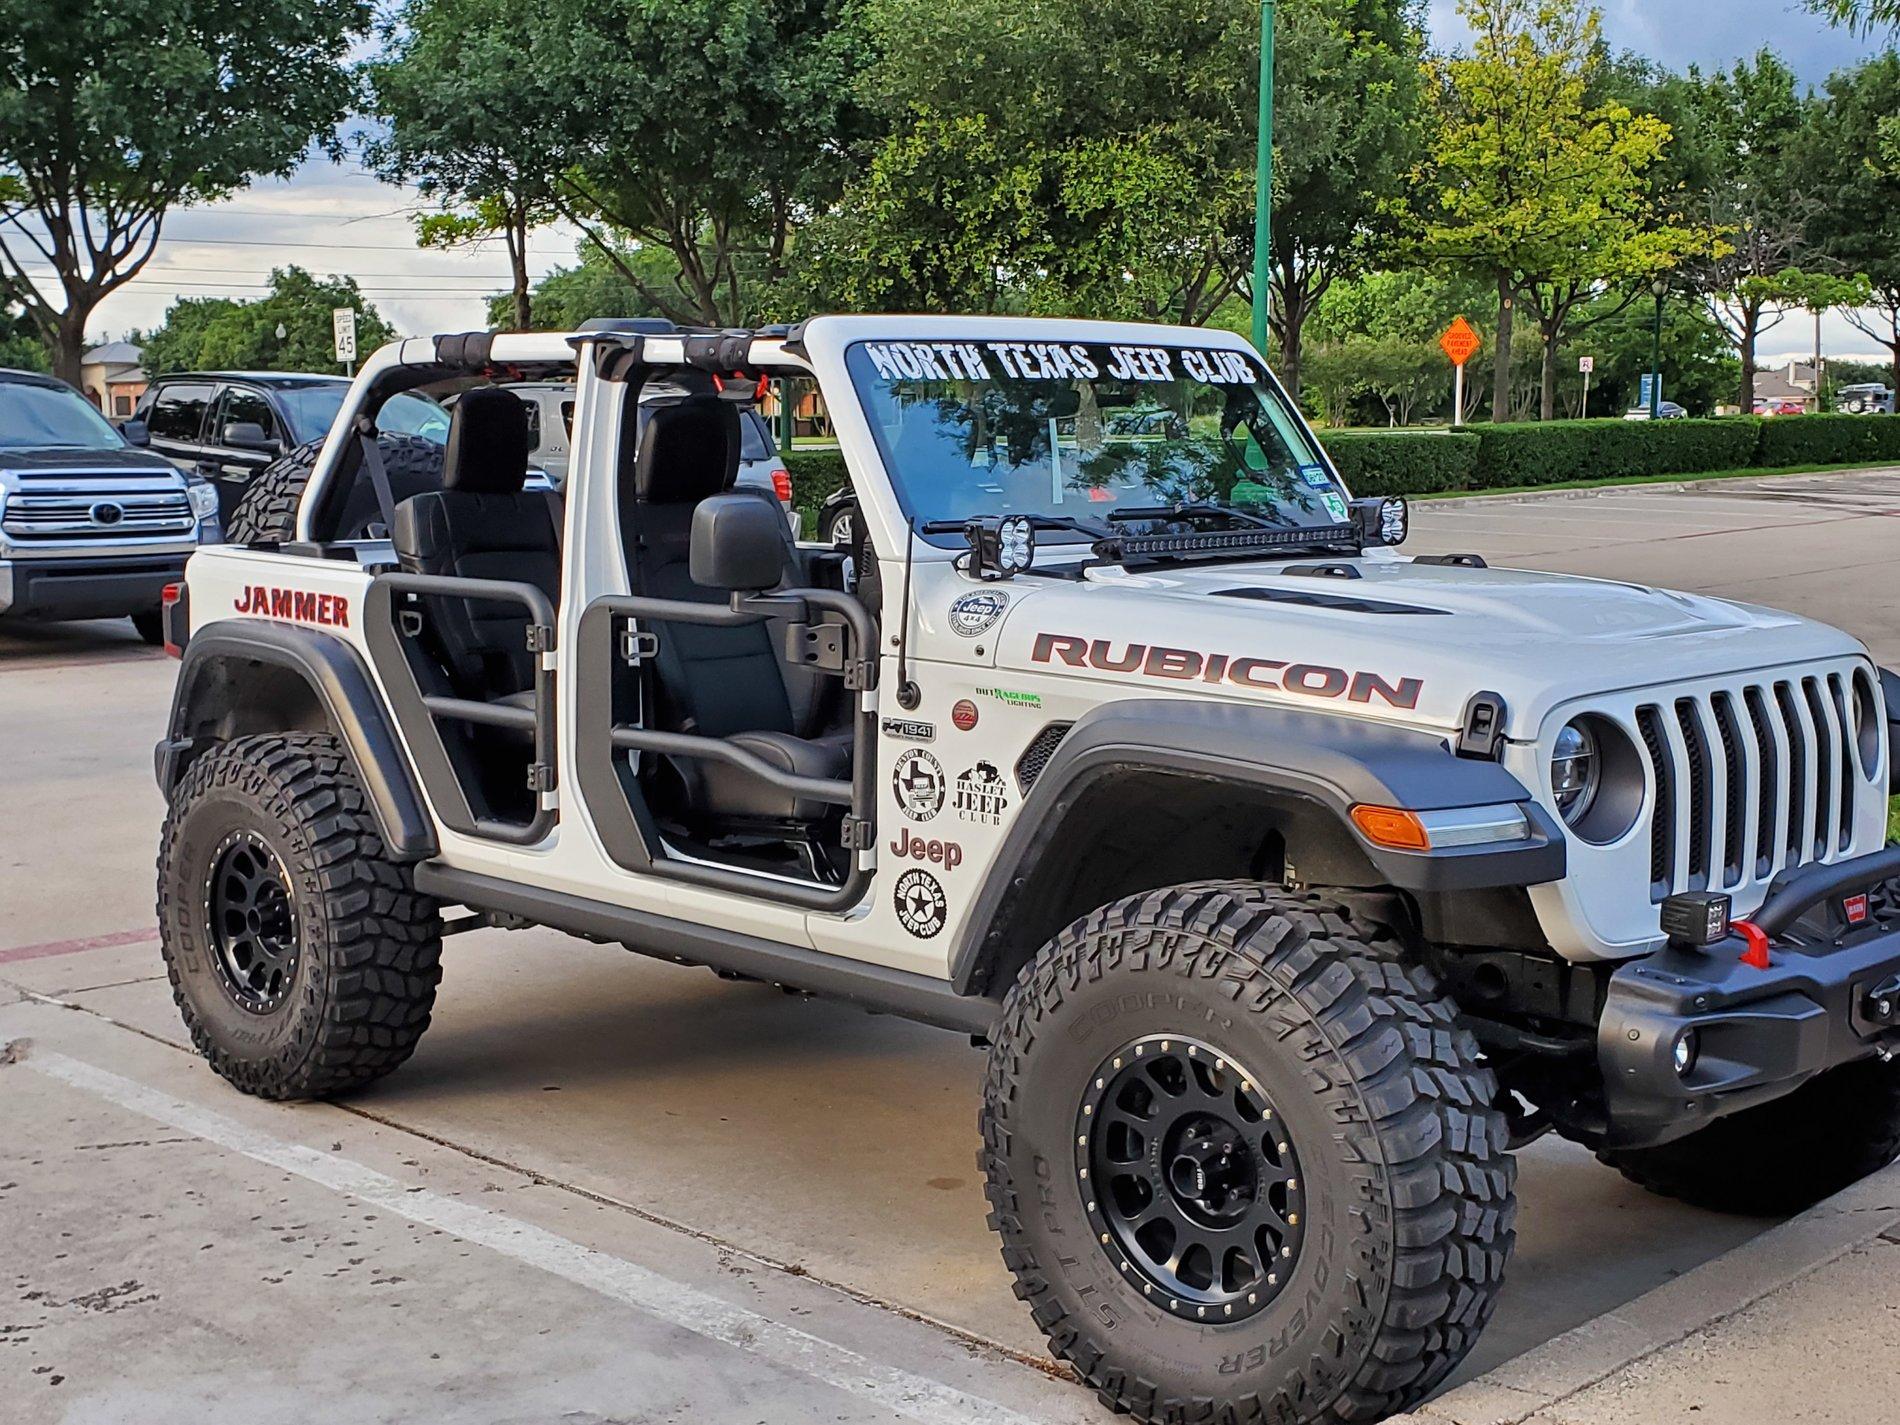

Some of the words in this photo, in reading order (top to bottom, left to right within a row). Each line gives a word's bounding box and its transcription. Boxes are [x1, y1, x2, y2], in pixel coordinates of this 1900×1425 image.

[336, 314, 352, 323] SPEED
[338, 336, 353, 354] 45
[868, 343, 991, 380] NORTH
[987, 344, 1099, 379] TEXAS
[1106, 346, 1175, 382] JEEP
[1180, 350, 1257, 384] CLUB
[234, 585, 349, 628] JAMMER
[962, 602, 993, 616] Jeep
[1031, 632, 1424, 709] RUBICON
[1006, 699, 1042, 709] LIGHTING
[904, 724, 932, 737] 1941
[896, 749, 918, 772] DENTON
[921, 750, 943, 776] COUNTY
[957, 780, 1006, 796] HASLET
[952, 791, 1008, 815] JEEP
[959, 810, 1000, 826] CLUB
[890, 827, 962, 871] Jeep
[897, 872, 920, 899] NORTH
[920, 873, 944, 907] TEXAS
[177, 841, 201, 974] COOPER
[899, 910, 919, 932] JEEP
[920, 917, 941, 935] CLUB
[1066, 992, 1233, 1044] COOPER
[1052, 1249, 1124, 1331] STT
